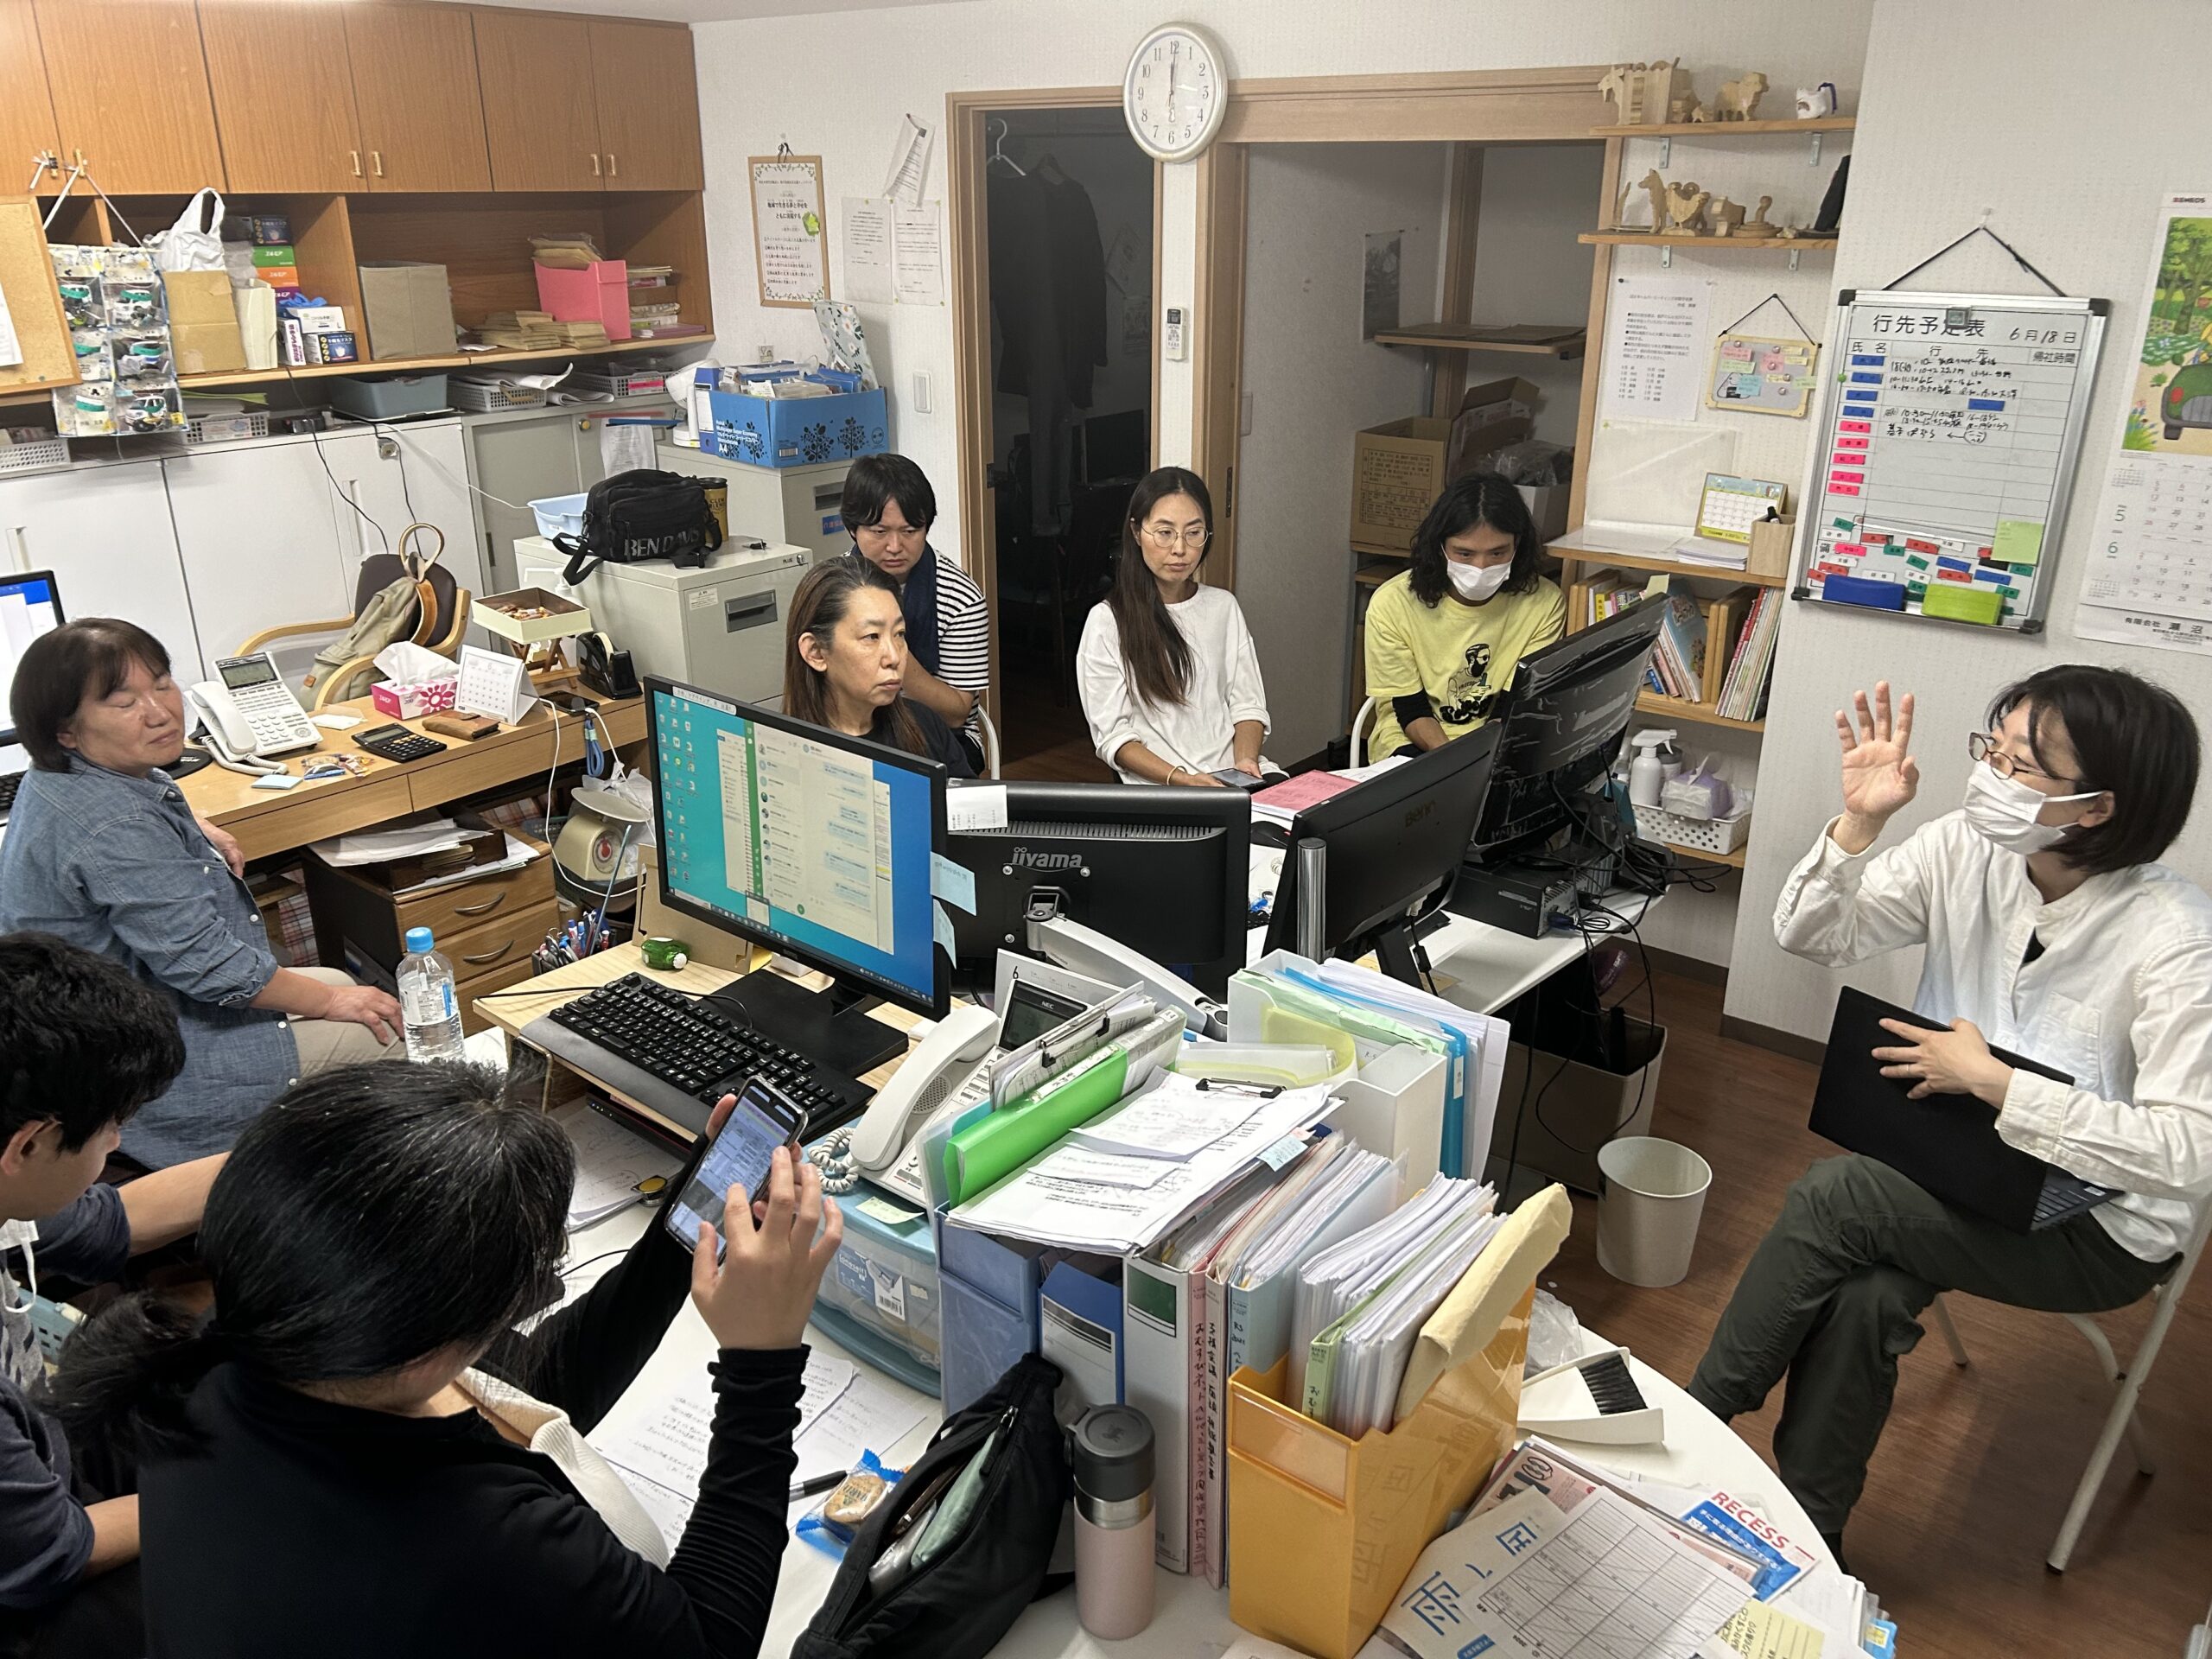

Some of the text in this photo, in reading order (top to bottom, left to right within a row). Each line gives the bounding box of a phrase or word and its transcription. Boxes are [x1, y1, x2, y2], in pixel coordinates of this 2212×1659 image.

[1154, 47, 1162, 61] 11
[1169, 40, 1180, 54] 12
[1188, 46, 1192, 60] 1
[1141, 64, 1151, 78] 10
[1198, 62, 1206, 76] 2
[1137, 86, 1145, 101] 9
[1202, 86, 1210, 99] 3
[1141, 109, 1148, 122] 8
[1197, 108, 1204, 122] 4
[1153, 124, 1159, 138] 7
[1168, 130, 1175, 145] 6
[1184, 125, 1192, 139] 5
[719, 443, 728, 454] A4
[2114, 509, 2126, 522] 5
[624, 536, 660, 558] BEN
[2107, 541, 2119, 554] 6
[2125, 617, 2161, 628] 有限会社
[1012, 846, 1083, 868] iiyama
[1013, 965, 1019, 979] 6
[1041, 1001, 1054, 1010] NEC
[1711, 1491, 1790, 1549] RECESS
